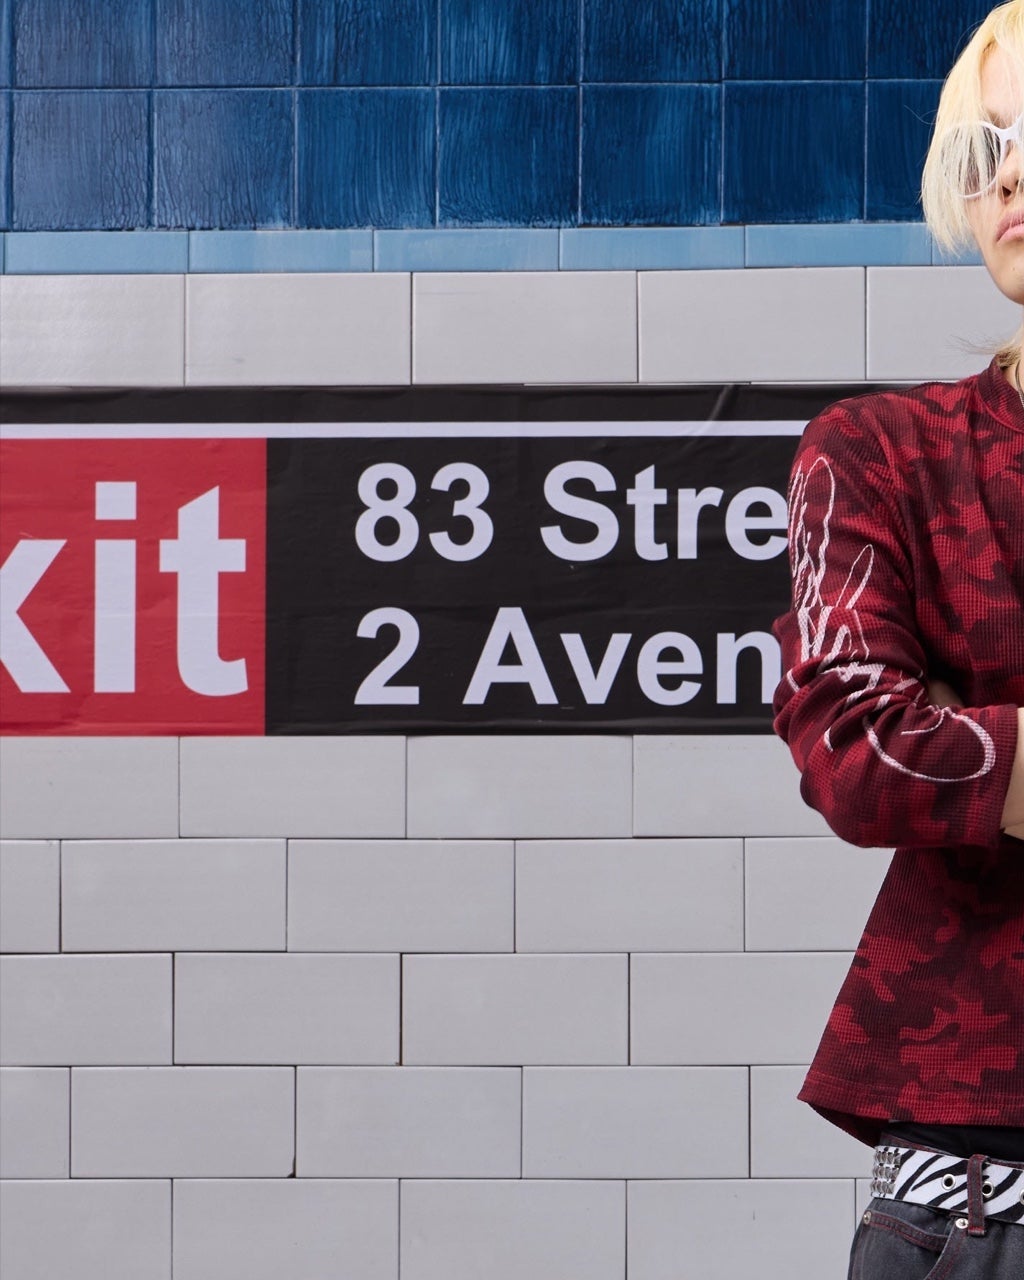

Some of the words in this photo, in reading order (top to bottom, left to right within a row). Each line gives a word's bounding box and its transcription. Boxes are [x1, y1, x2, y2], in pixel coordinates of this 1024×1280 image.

[355, 462, 494, 562] 83
[540, 460, 788, 562] Stre
[354, 606, 420, 705] 2
[462, 606, 782, 706] Aven
